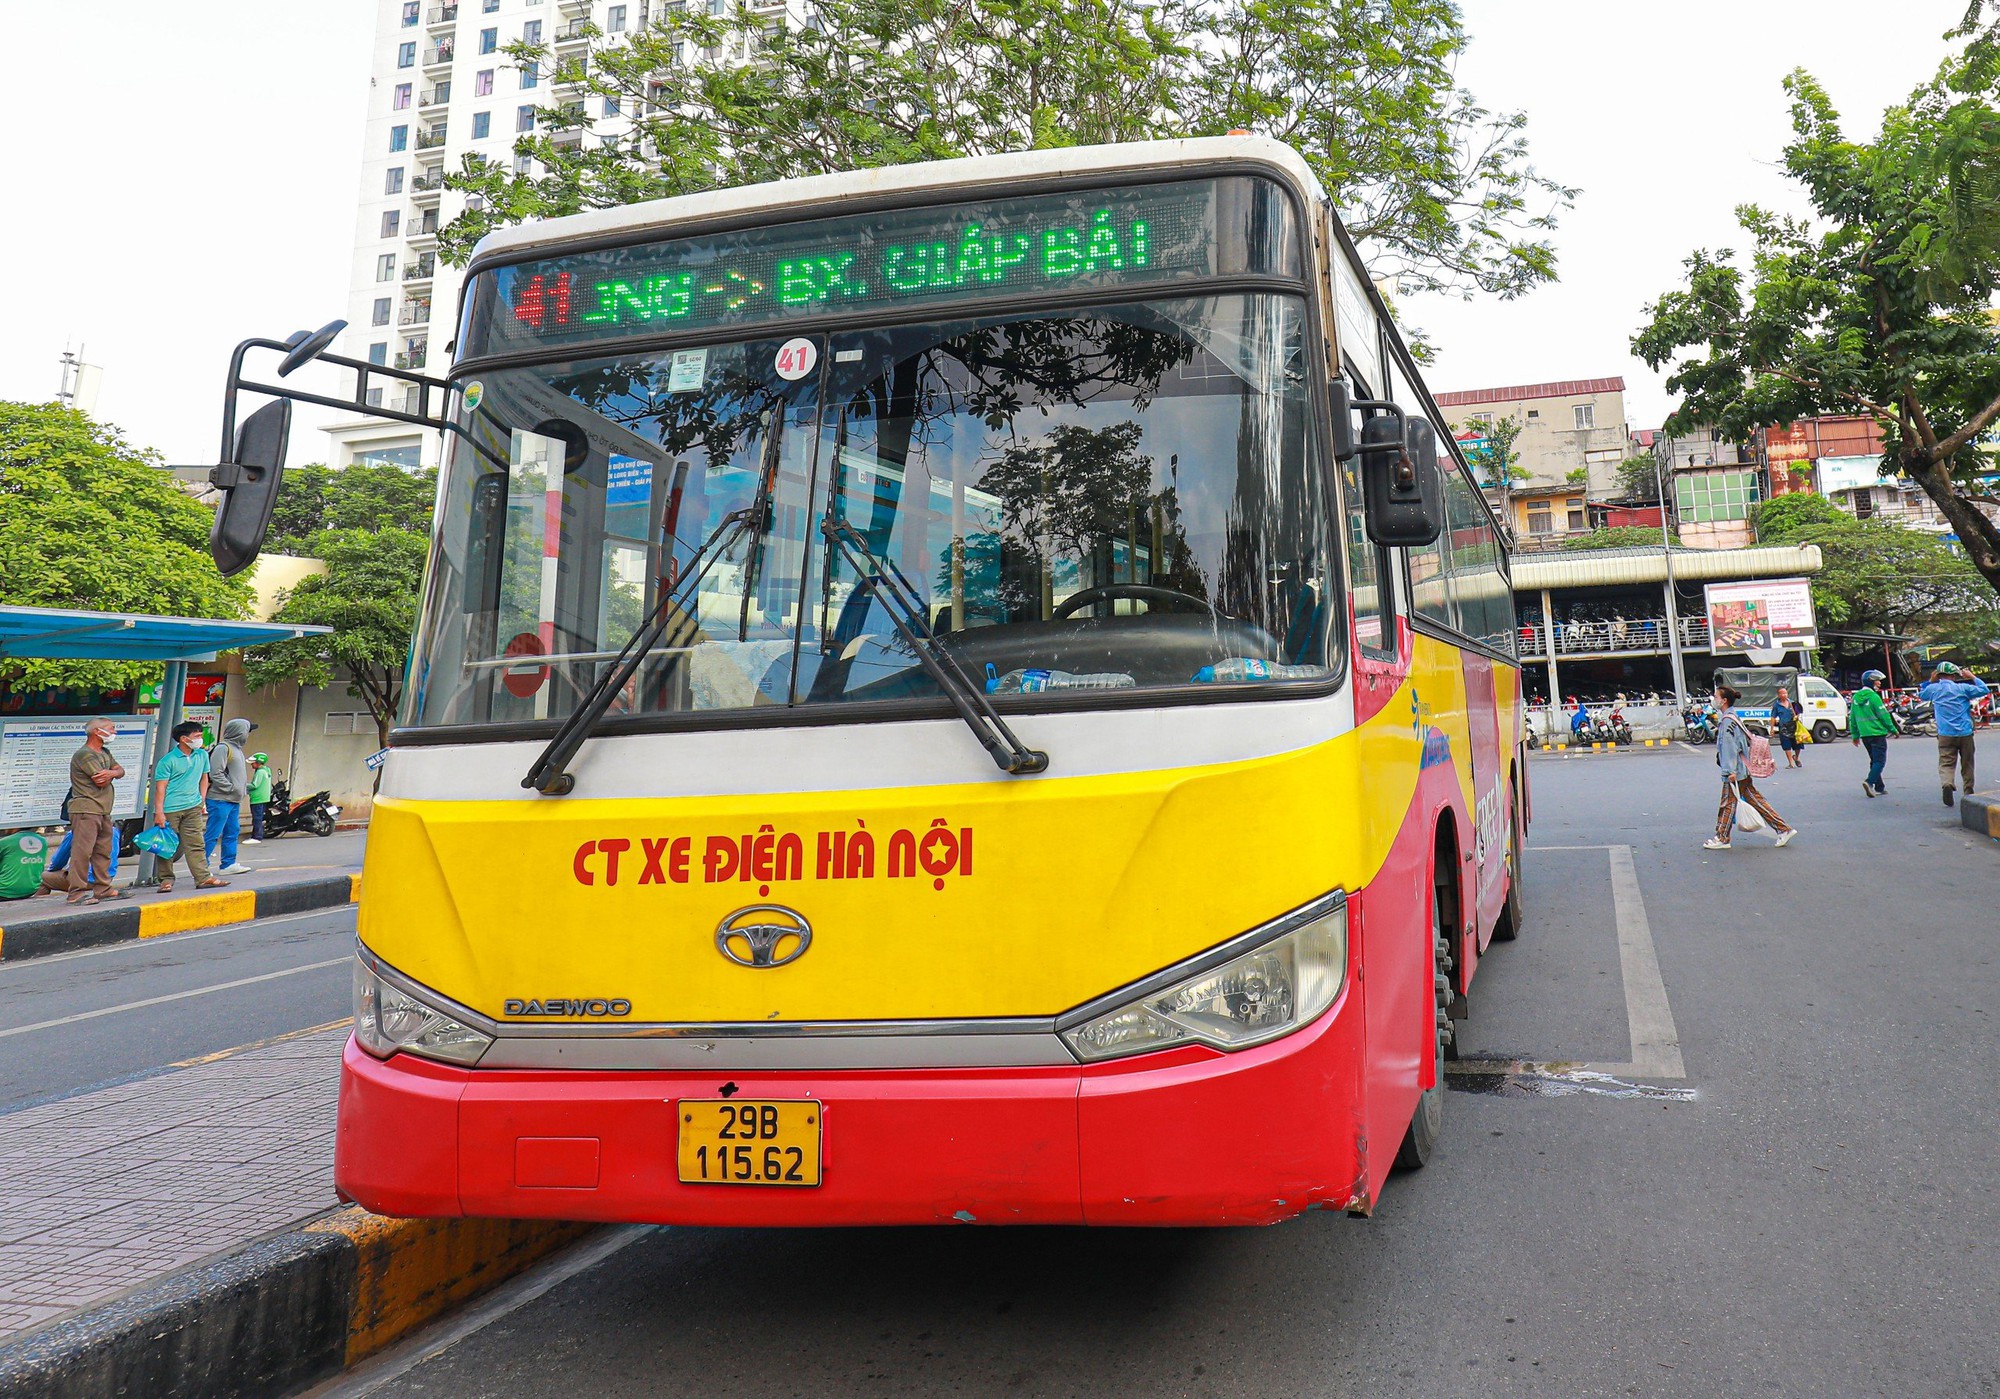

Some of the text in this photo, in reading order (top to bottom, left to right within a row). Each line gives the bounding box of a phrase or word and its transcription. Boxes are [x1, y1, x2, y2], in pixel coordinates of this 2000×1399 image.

[514, 273, 571, 328] 41
[777, 346, 807, 372] 41
[20, 856, 43, 864] Grab
[573, 839, 631, 886] CT
[638, 837, 692, 885] XE
[816, 818, 875, 880] HÀ
[887, 818, 973, 891] NỘI
[503, 998, 632, 1017] DAEWOO
[718, 1105, 779, 1140] 29B
[696, 1145, 804, 1182] 115.62
